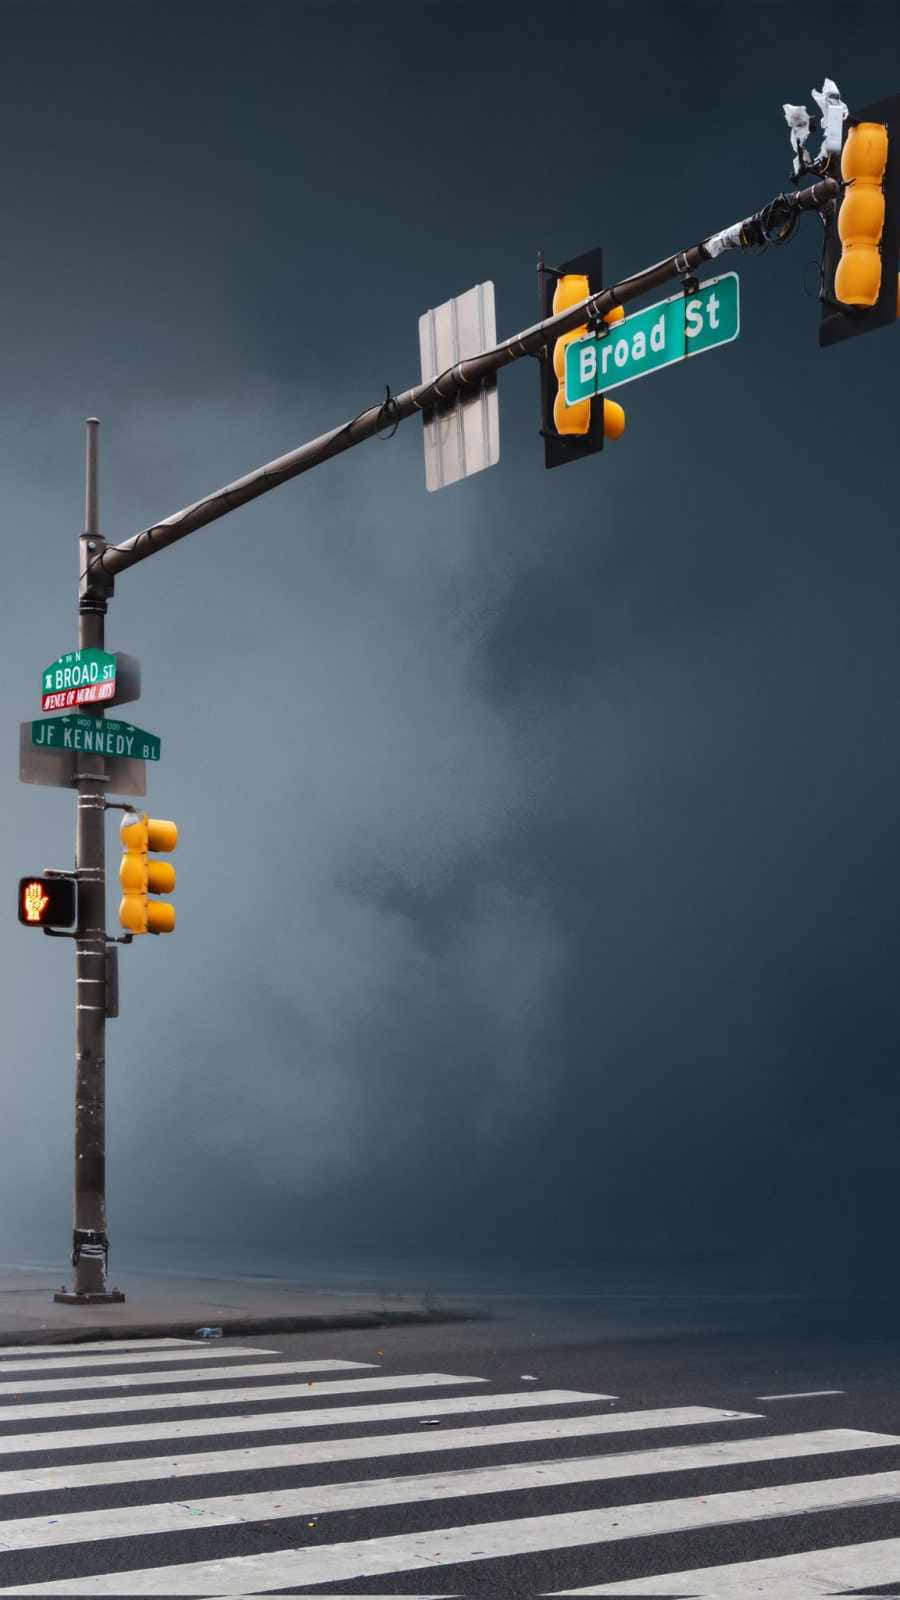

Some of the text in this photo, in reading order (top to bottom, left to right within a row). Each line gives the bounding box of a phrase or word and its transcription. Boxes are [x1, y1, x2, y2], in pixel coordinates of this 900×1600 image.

[579, 293, 720, 384] Broad St
[75, 652, 81, 662] N
[56, 662, 113, 689] BROAD ST
[96, 719, 102, 730] W
[36, 725, 157, 760] JF KENNEDY BL
